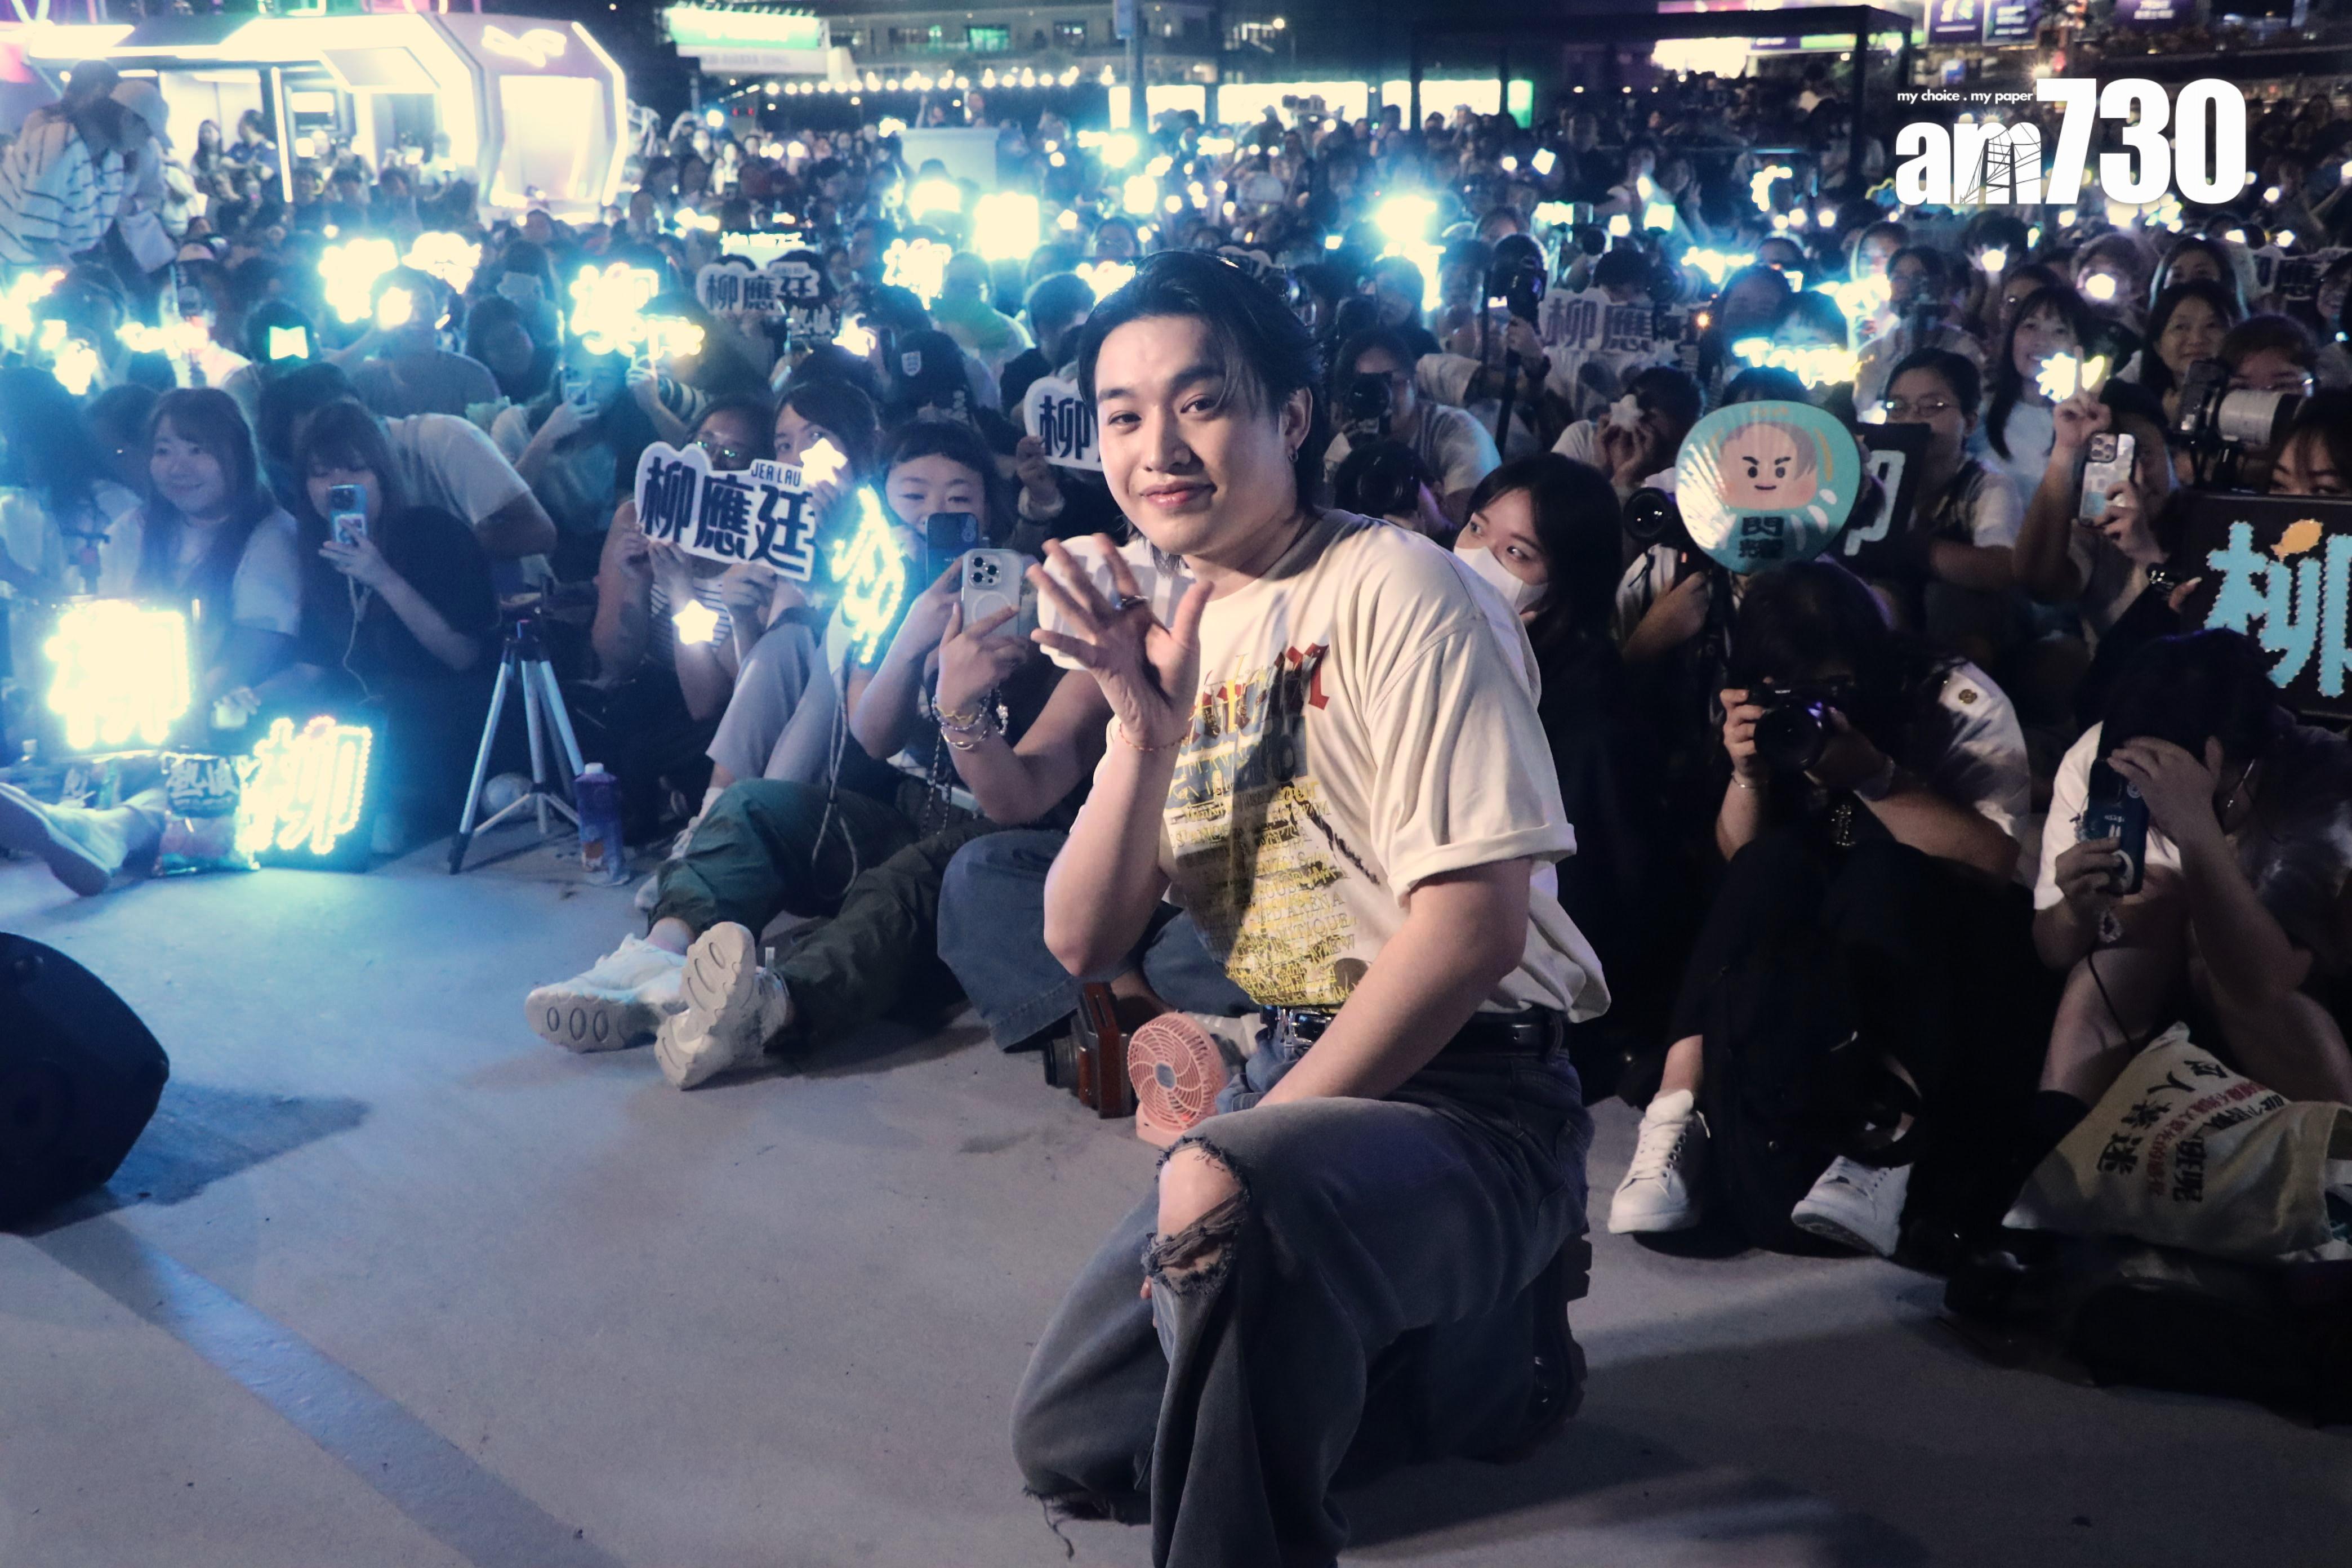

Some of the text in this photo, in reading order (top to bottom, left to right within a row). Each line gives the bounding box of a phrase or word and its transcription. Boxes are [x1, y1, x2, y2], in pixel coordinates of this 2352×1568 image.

[751, 462, 801, 487] JER LAU
[640, 457, 816, 573] 柳應廷
